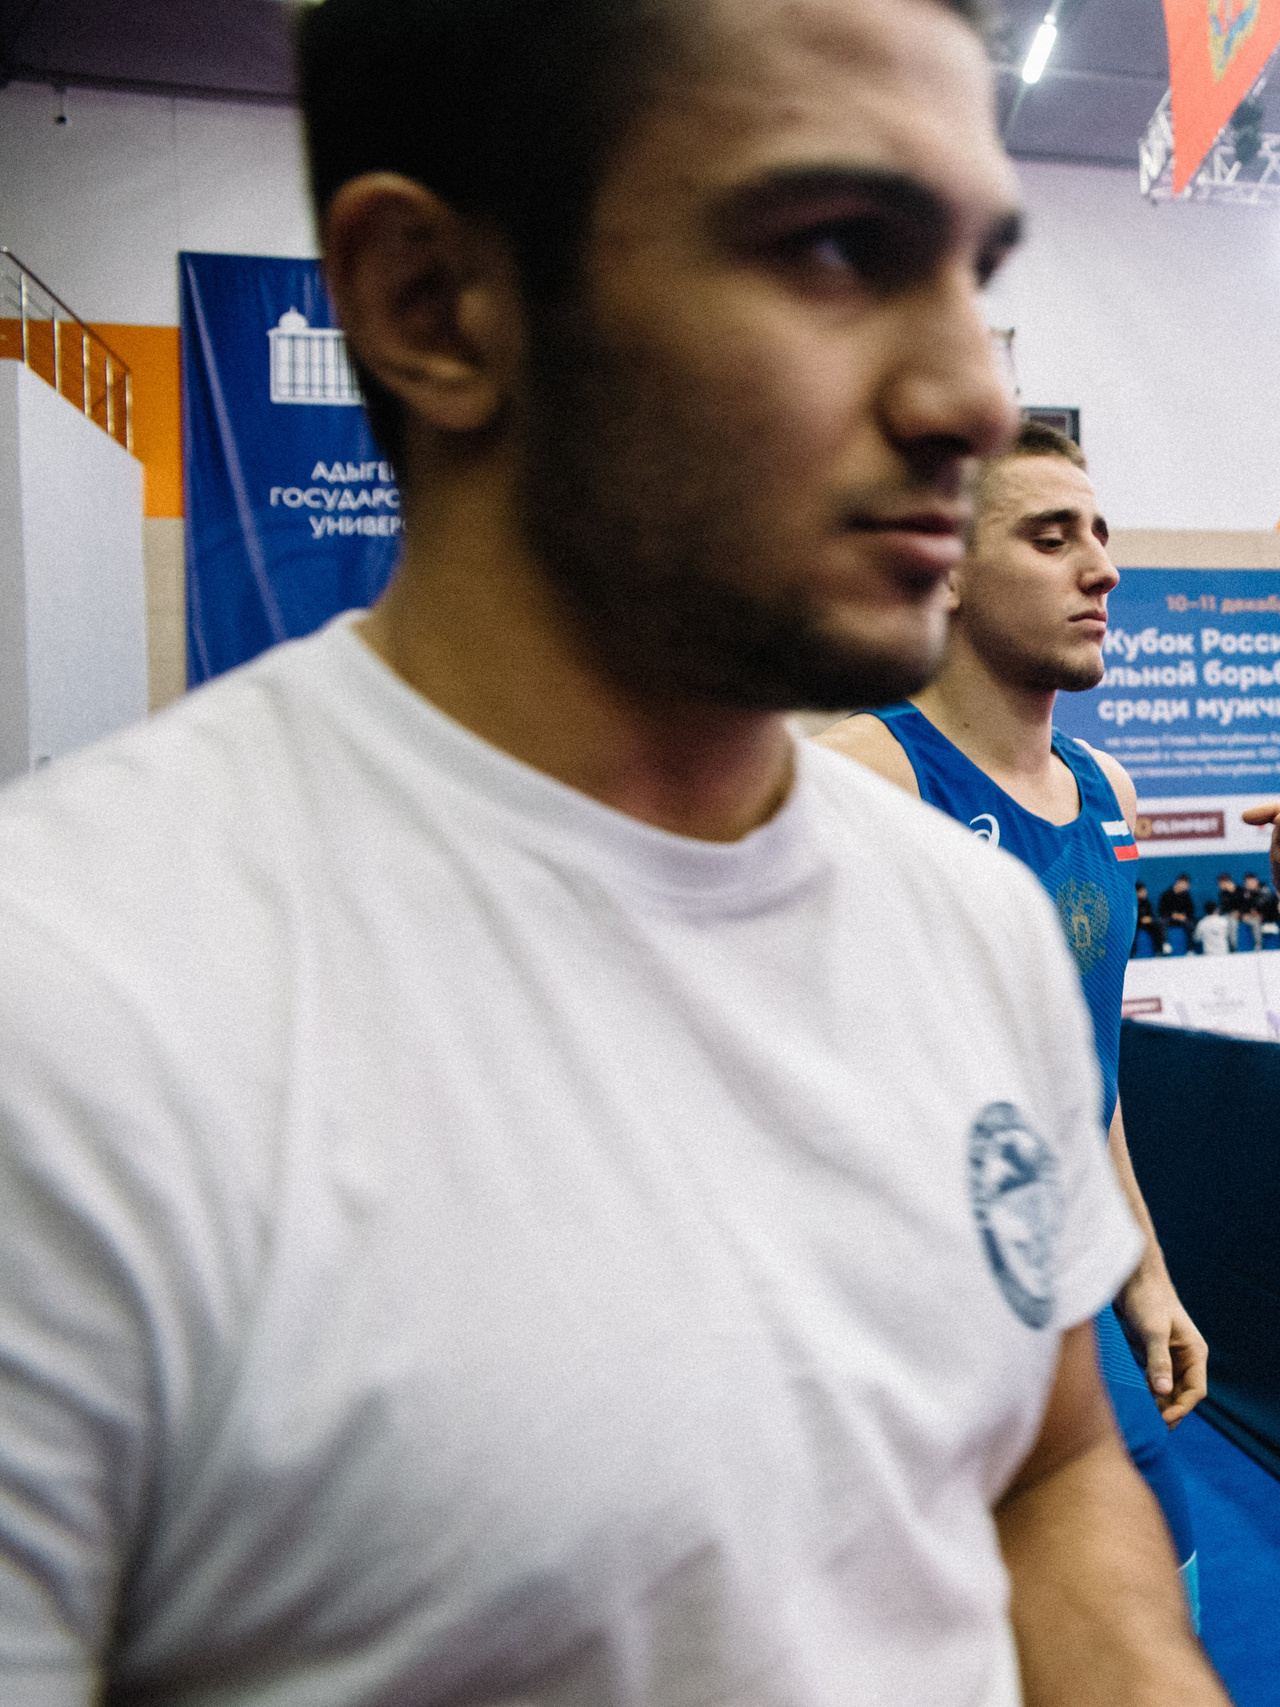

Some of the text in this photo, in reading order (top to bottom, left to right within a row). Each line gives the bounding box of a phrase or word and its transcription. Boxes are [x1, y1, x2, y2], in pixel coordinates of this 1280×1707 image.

[311, 461, 396, 484] АДЫГЕ
[309, 515, 406, 539] УНИВЕР
[1104, 628, 1194, 662] Кубок
[1097, 660, 1196, 687] льной
[1098, 699, 1190, 726] среди
